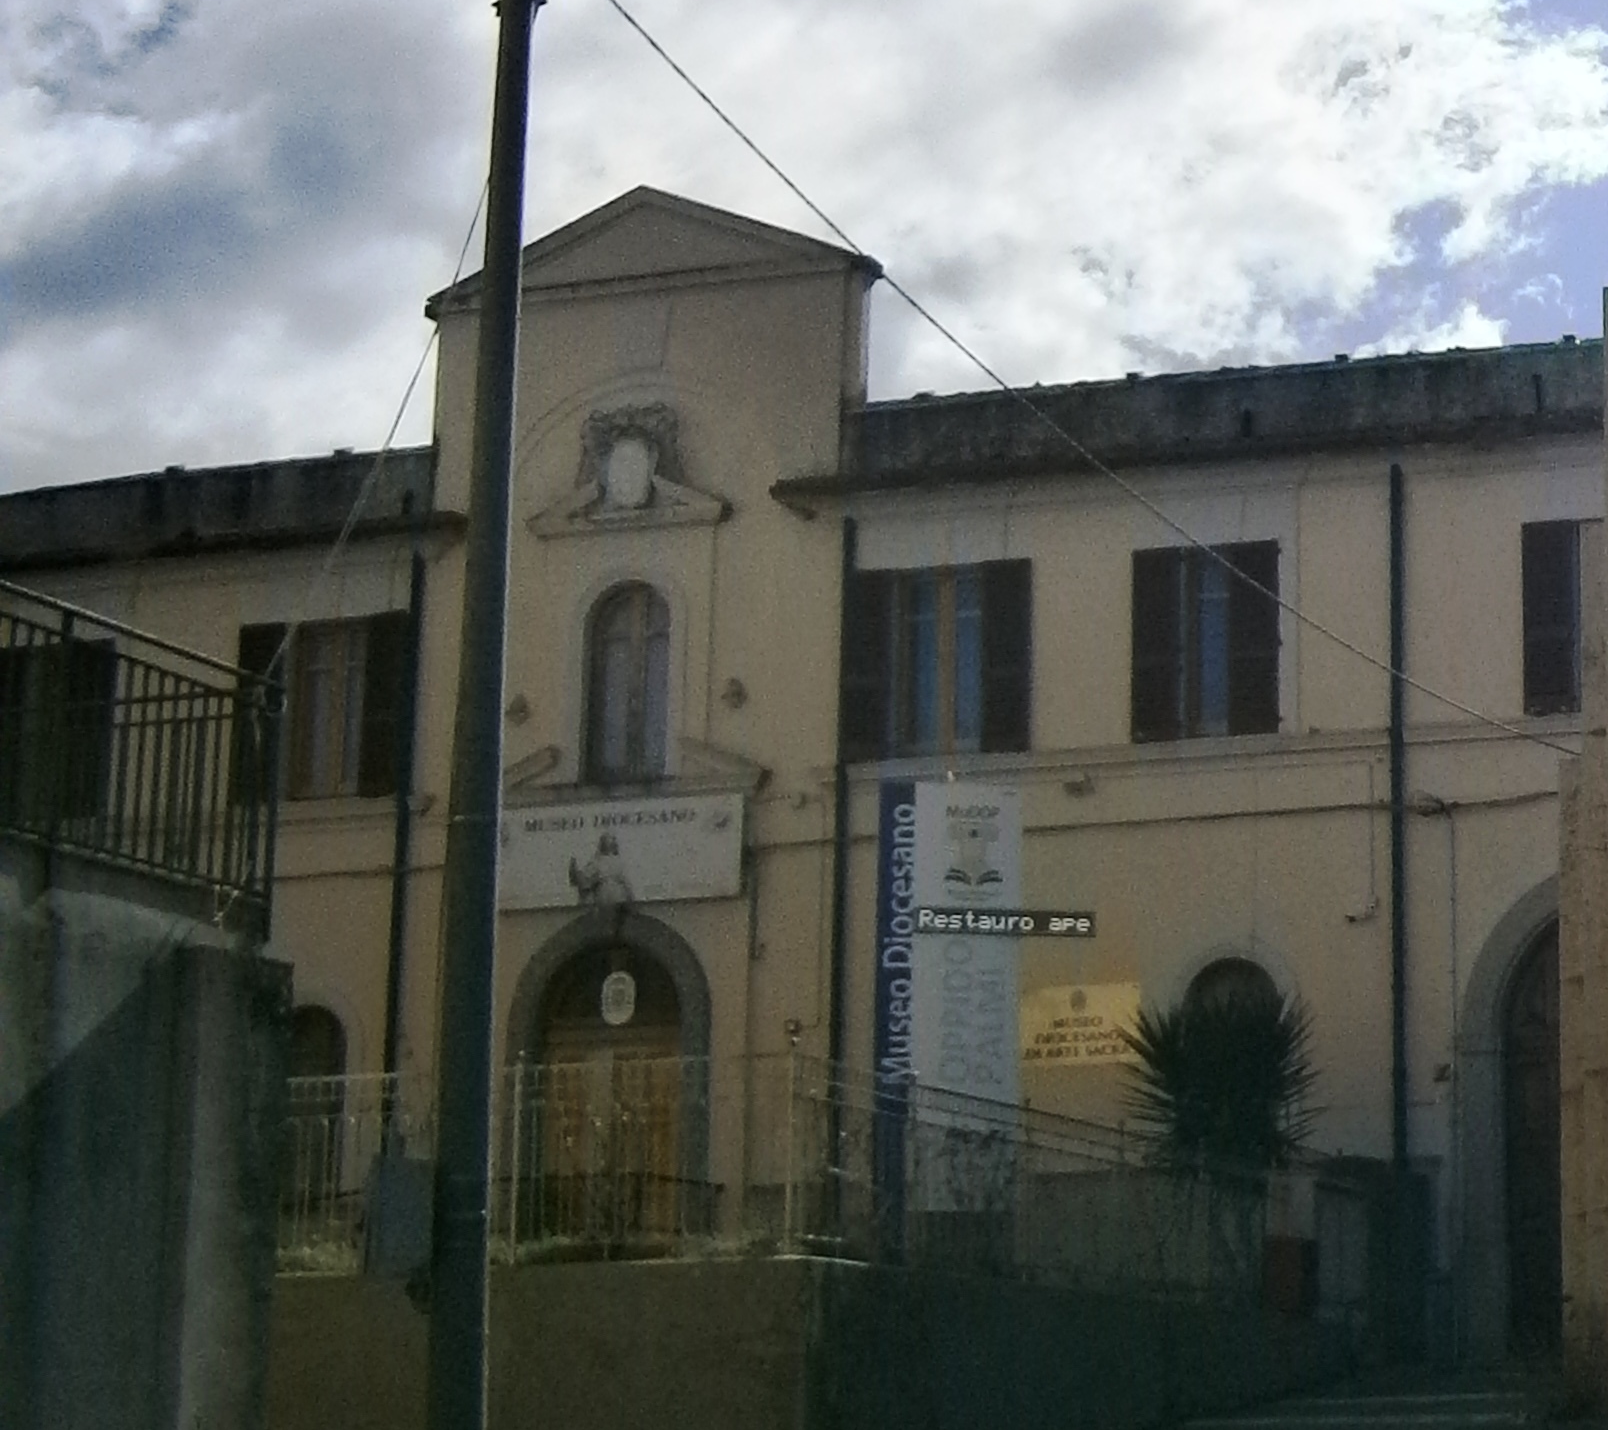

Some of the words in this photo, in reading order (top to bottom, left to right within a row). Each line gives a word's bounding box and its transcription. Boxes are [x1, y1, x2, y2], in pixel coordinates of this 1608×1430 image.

[881, 803, 916, 969] Diocesano
[917, 908, 1035, 931] Restauro
[1048, 916, 1092, 932] ape
[879, 977, 914, 1085] Museo
